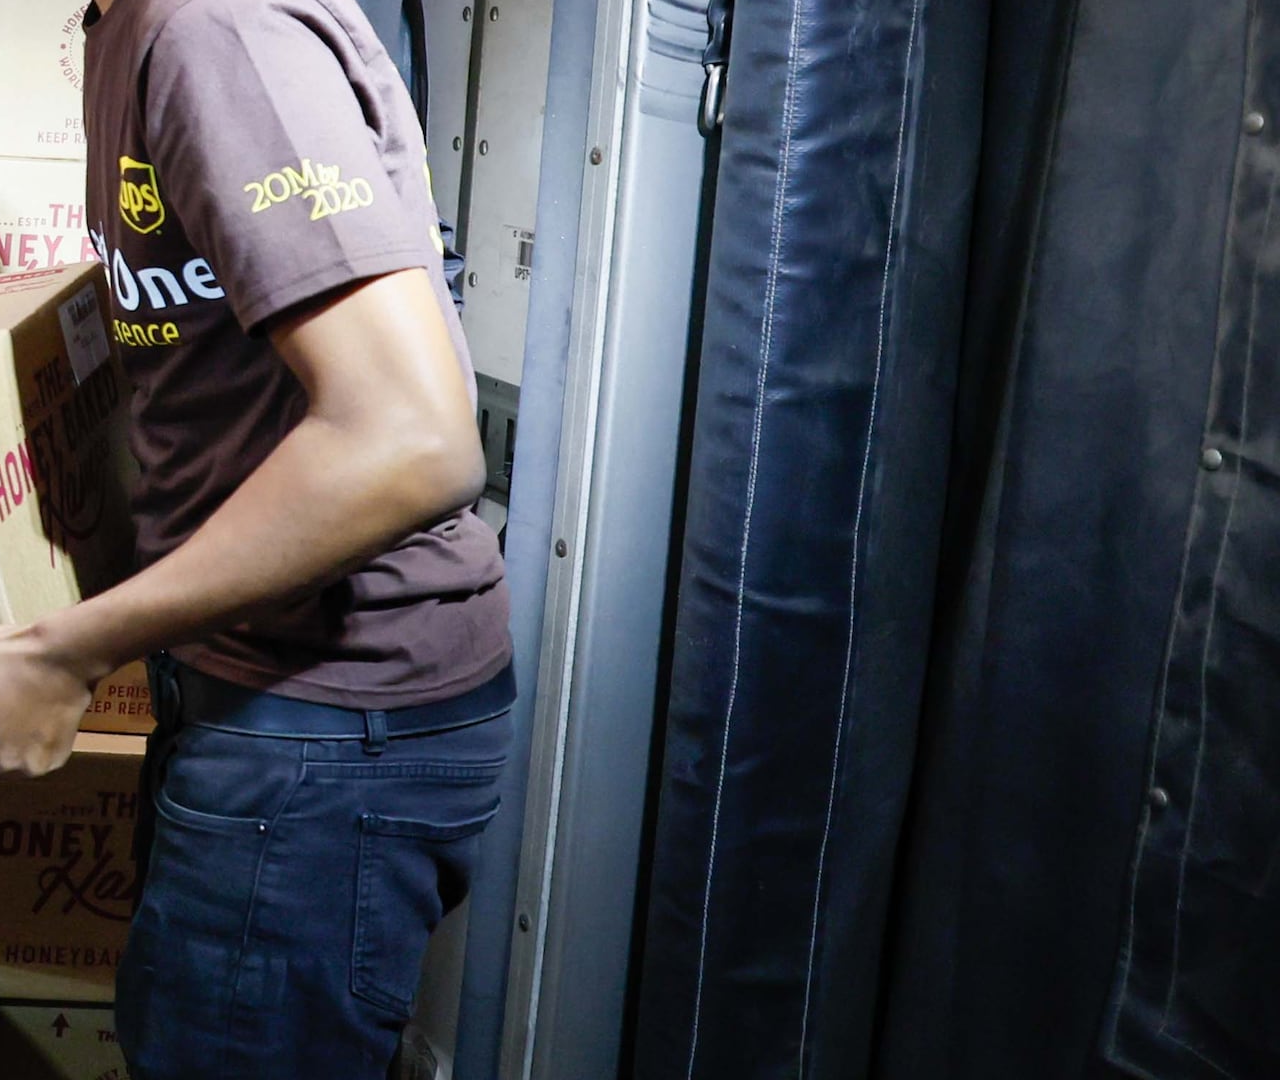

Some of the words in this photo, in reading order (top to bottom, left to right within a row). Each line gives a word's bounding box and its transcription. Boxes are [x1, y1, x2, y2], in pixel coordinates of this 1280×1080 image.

[37, 131, 69, 143] KEEP
[244, 158, 317, 213] 20M
[302, 177, 374, 221] 2020
[49, 204, 83, 228] TH
[112, 248, 226, 311] One
[97, 791, 138, 819] TH
